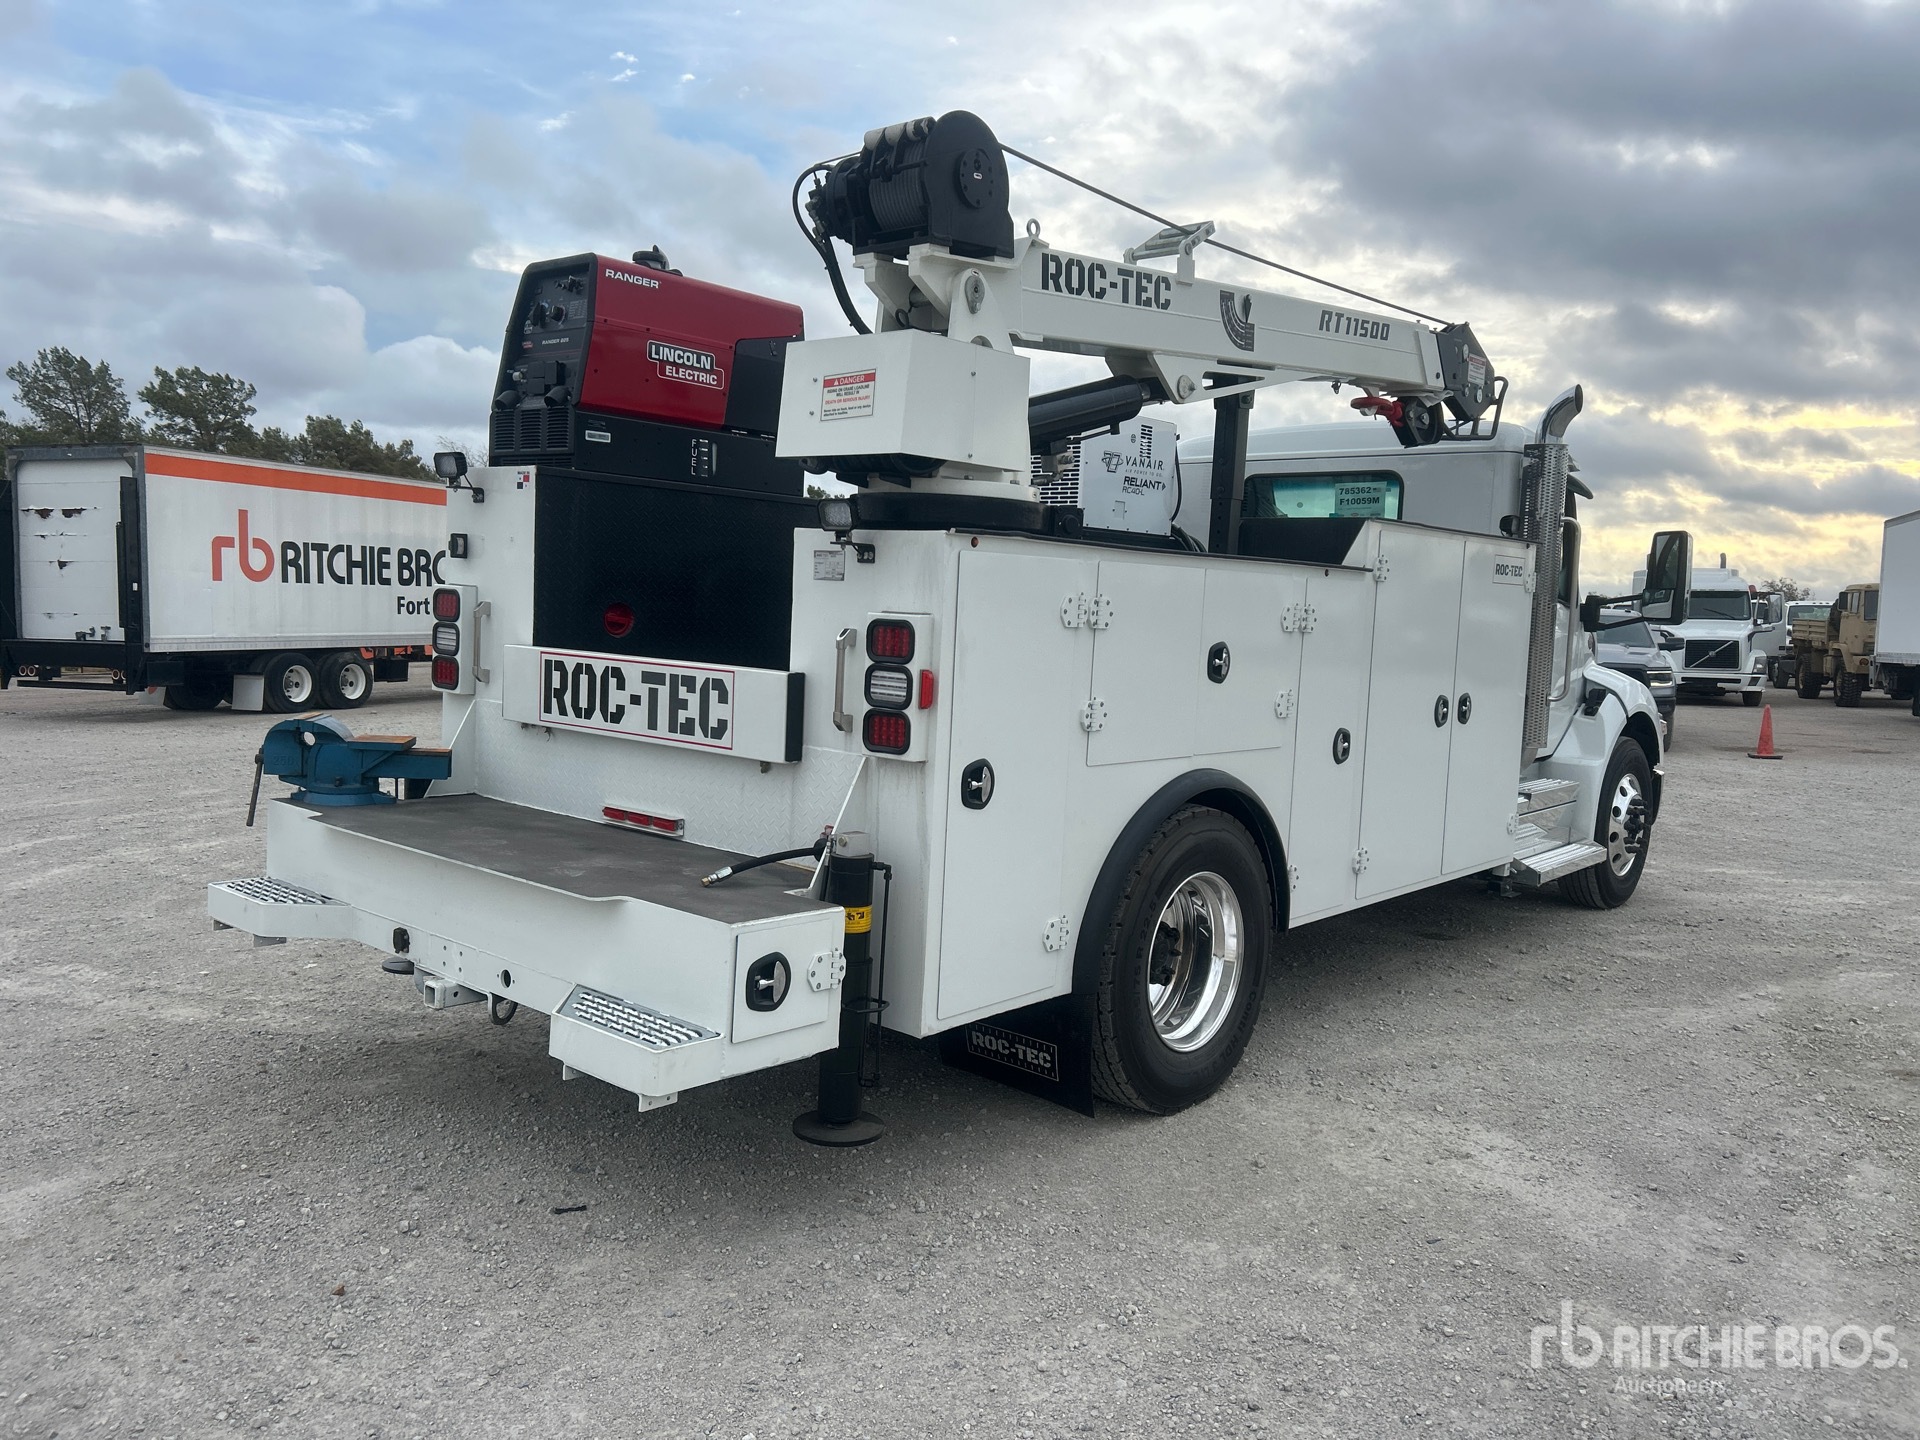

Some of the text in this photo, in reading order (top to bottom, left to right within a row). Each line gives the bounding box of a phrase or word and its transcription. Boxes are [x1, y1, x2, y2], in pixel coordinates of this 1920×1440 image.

[605, 268, 659, 289] RANGER
[1041, 252, 1171, 310] ROC-TEC
[1319, 309, 1390, 341] RT11500
[651, 344, 711, 370] LINCOLN
[665, 365, 717, 385] ELECTRIC
[839, 375, 865, 385] DANGER
[1125, 455, 1163, 471] VANAIR
[1123, 475, 1162, 490] RELIANT
[1339, 486, 1372, 495] 785362
[1339, 496, 1380, 506] F10059M
[212, 508, 275, 583] rb
[281, 541, 391, 586] RITCHIE
[1495, 563, 1523, 578] ROC-TEC
[397, 595, 430, 615] Fort
[543, 659, 729, 741] ROC-TEC
[971, 1030, 1051, 1068] ROC-TEC
